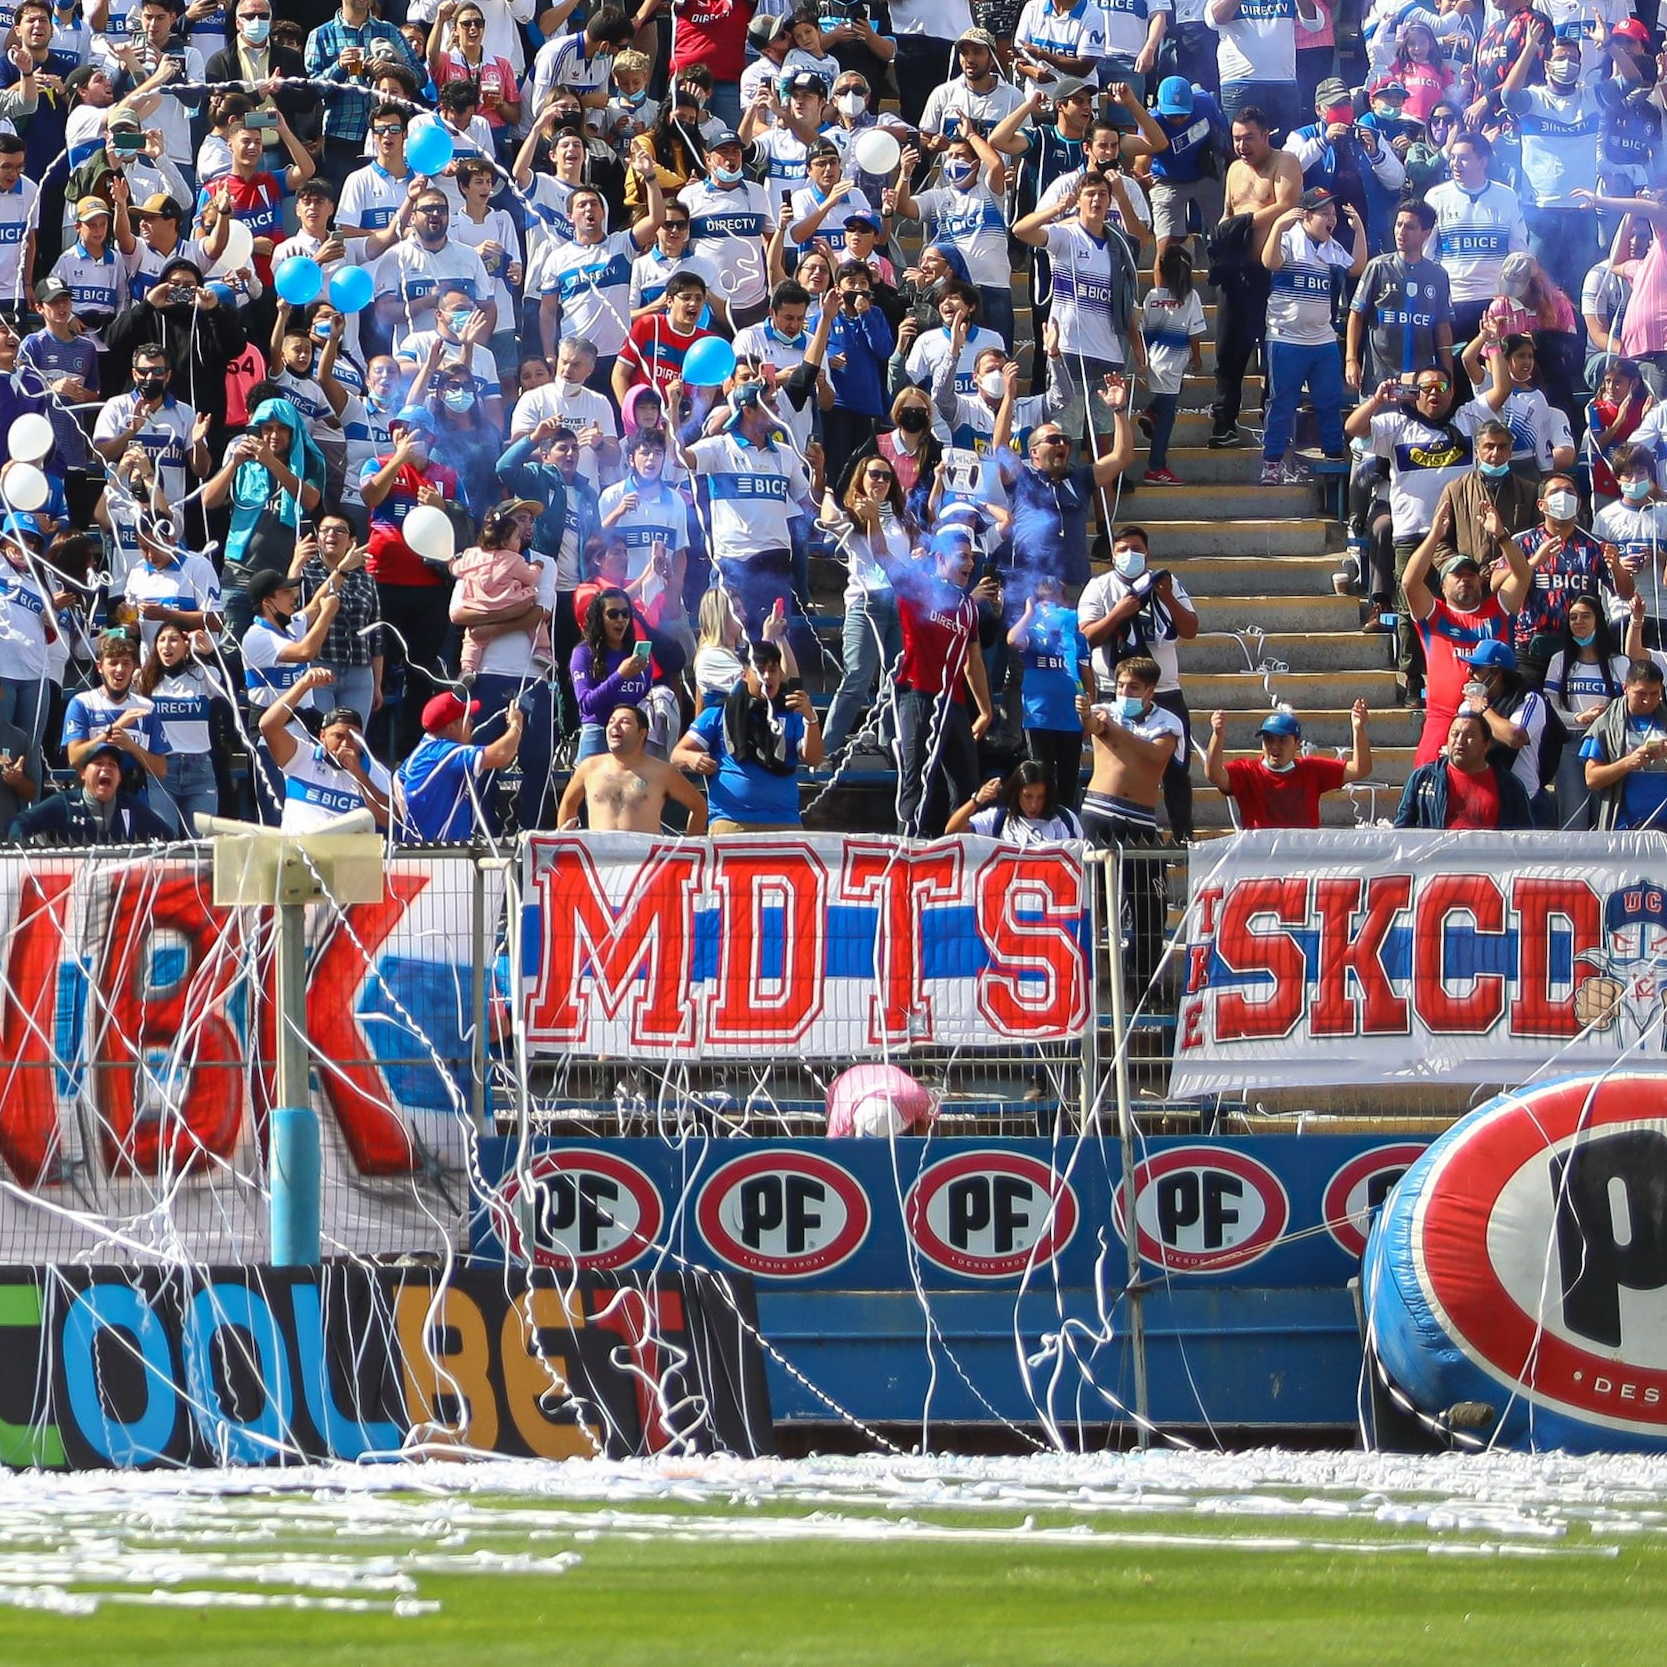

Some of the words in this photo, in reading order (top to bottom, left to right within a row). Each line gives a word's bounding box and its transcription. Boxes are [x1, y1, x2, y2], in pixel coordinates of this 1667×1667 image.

[1241, 2, 1288, 18] DIRECTV
[1481, 46, 1507, 58] BICE
[785, 165, 806, 176] BIC
[707, 218, 756, 233] DIRECTV
[1463, 237, 1497, 250] BICE
[83, 288, 109, 301] BICE
[1398, 311, 1430, 326] BICE
[954, 379, 977, 390] BIC
[755, 479, 787, 496] BICE
[1552, 575, 1588, 591] BICE
[1566, 679, 1606, 695] DIRECT
[156, 700, 203, 714] IRECTV
[323, 794, 360, 809] BICE
[1622, 888, 1664, 913] UC
[524, 835, 1091, 1051] MDTS
[1181, 886, 1225, 1051] THE
[1214, 872, 1604, 1041] SKCD
[535, 1173, 620, 1253] PF
[740, 1173, 826, 1254] PF
[947, 1174, 1034, 1254] PF
[1156, 1170, 1244, 1249] PF
[1548, 1126, 1667, 1349] P
[749, 1256, 789, 1270] DESDE
[957, 1256, 996, 1270] DESDE
[1592, 1374, 1661, 1403] DES
